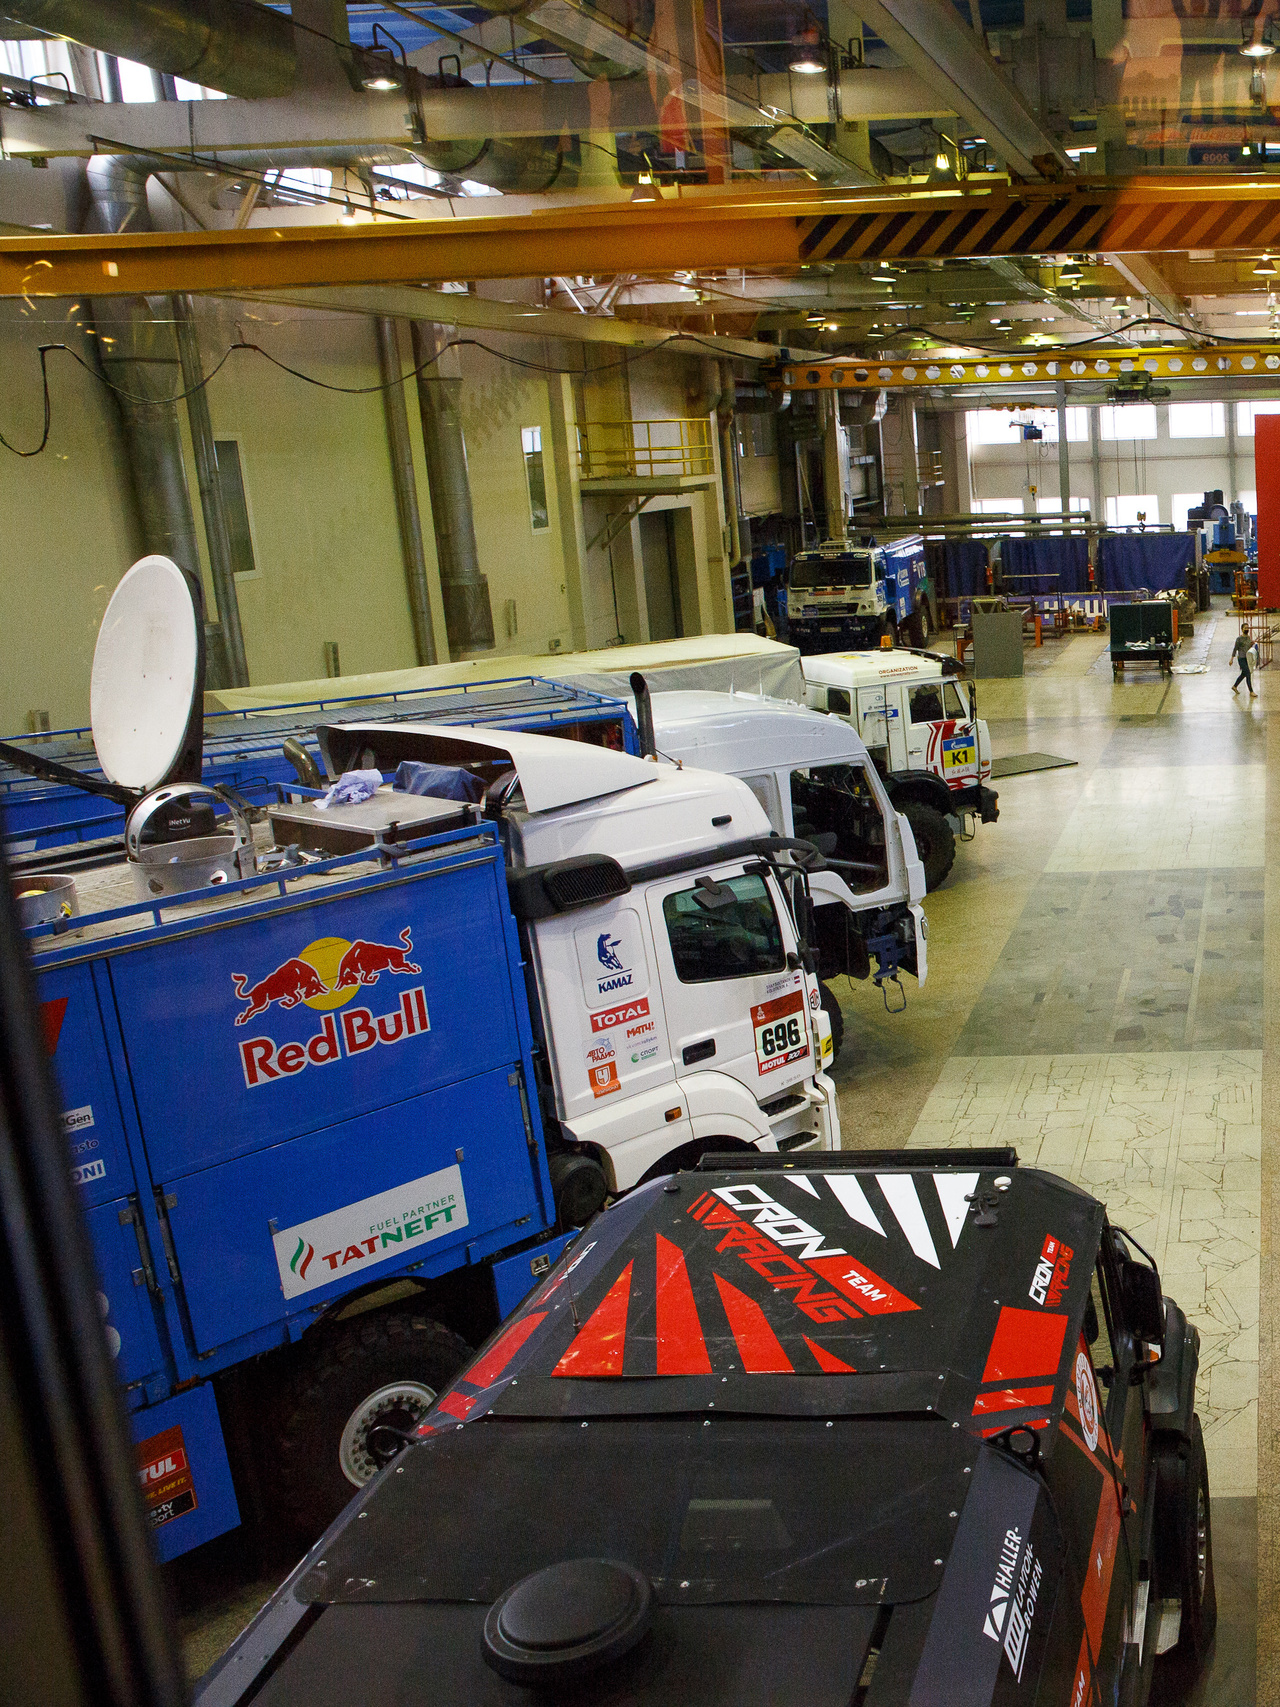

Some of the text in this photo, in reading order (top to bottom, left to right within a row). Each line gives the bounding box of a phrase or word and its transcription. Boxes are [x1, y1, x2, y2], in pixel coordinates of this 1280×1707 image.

[878, 666, 918, 675] ORGANIZATION
[952, 749, 968, 765] K1
[598, 973, 633, 994] KAMAZ
[593, 1004, 648, 1028] TOTAL
[626, 1021, 655, 1039] МАТЧ!
[240, 985, 431, 1089] Red Bull
[586, 1046, 605, 1059] АВТО
[761, 1017, 801, 1056] 696
[592, 1049, 616, 1063] РАДИО
[761, 1056, 785, 1072] MOTUL
[369, 1194, 455, 1234] FUEL PARTNER
[711, 1183, 848, 1260] CRON
[321, 1204, 457, 1270] TATNEFT
[702, 1220, 865, 1324] RACING
[841, 1269, 888, 1302] TEAM
[1028, 1255, 1055, 1306] CRON
[995, 1526, 1022, 1590] HALLER-
[1023, 1558, 1043, 1630] BOWEN
